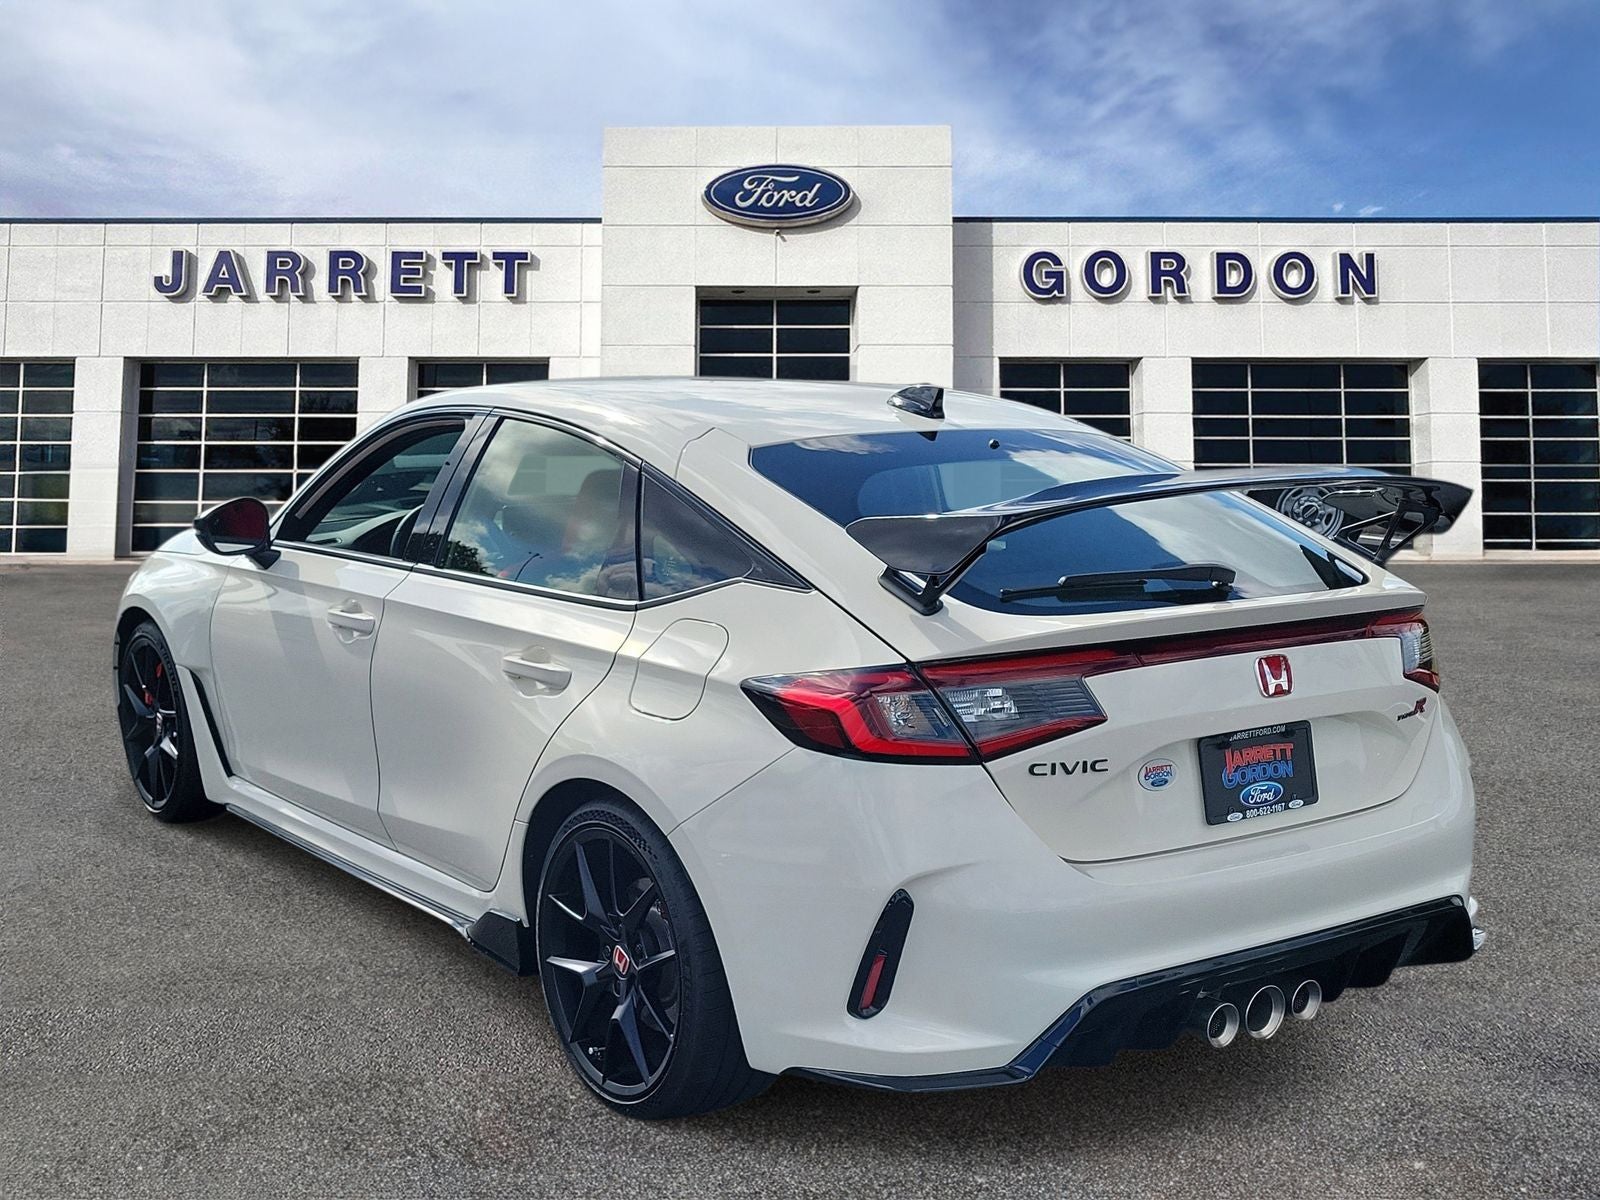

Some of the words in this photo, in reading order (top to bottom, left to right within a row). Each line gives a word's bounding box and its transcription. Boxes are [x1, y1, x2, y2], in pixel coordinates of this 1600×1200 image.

[735, 174, 822, 208] Ford
[153, 248, 531, 297] JARRETT
[1020, 248, 1379, 300] GORDON
[1229, 725, 1286, 741] JARRETTFORD.COM
[1028, 759, 1109, 776] CIVIC
[1222, 761, 1293, 789] GORDON
[1225, 743, 1293, 778] JARRETT
[1248, 785, 1275, 804] Ford
